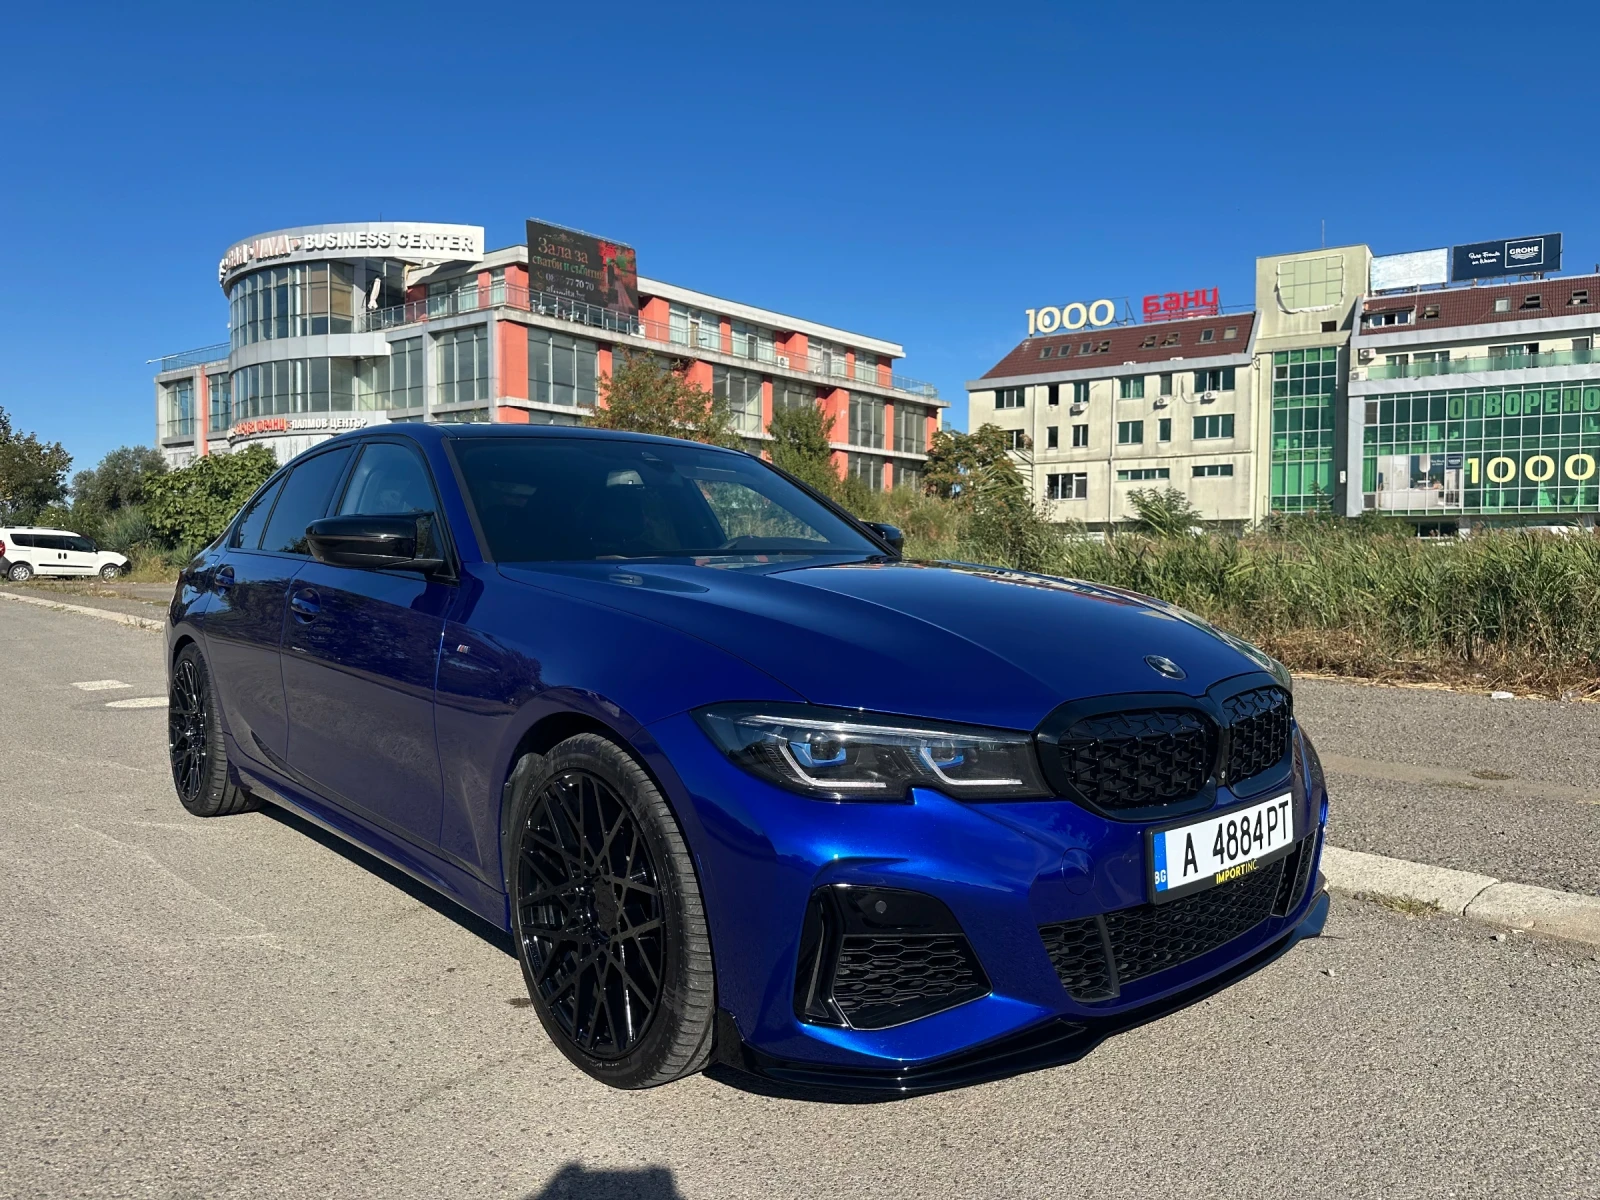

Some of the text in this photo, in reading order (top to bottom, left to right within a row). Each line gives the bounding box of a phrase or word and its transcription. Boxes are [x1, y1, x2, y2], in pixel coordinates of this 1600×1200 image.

[304, 232, 390, 250] BUSINESS
[397, 235, 474, 252] CENTER
[538, 237, 588, 264] Зала за
[1509, 245, 1539, 255] GROHE
[1025, 299, 1116, 335] 1000
[1449, 388, 1600, 419] ОТВОРЕНО
[1467, 454, 1596, 484] 1000
[1183, 832, 1199, 877] A
[1155, 869, 1167, 884] BG
